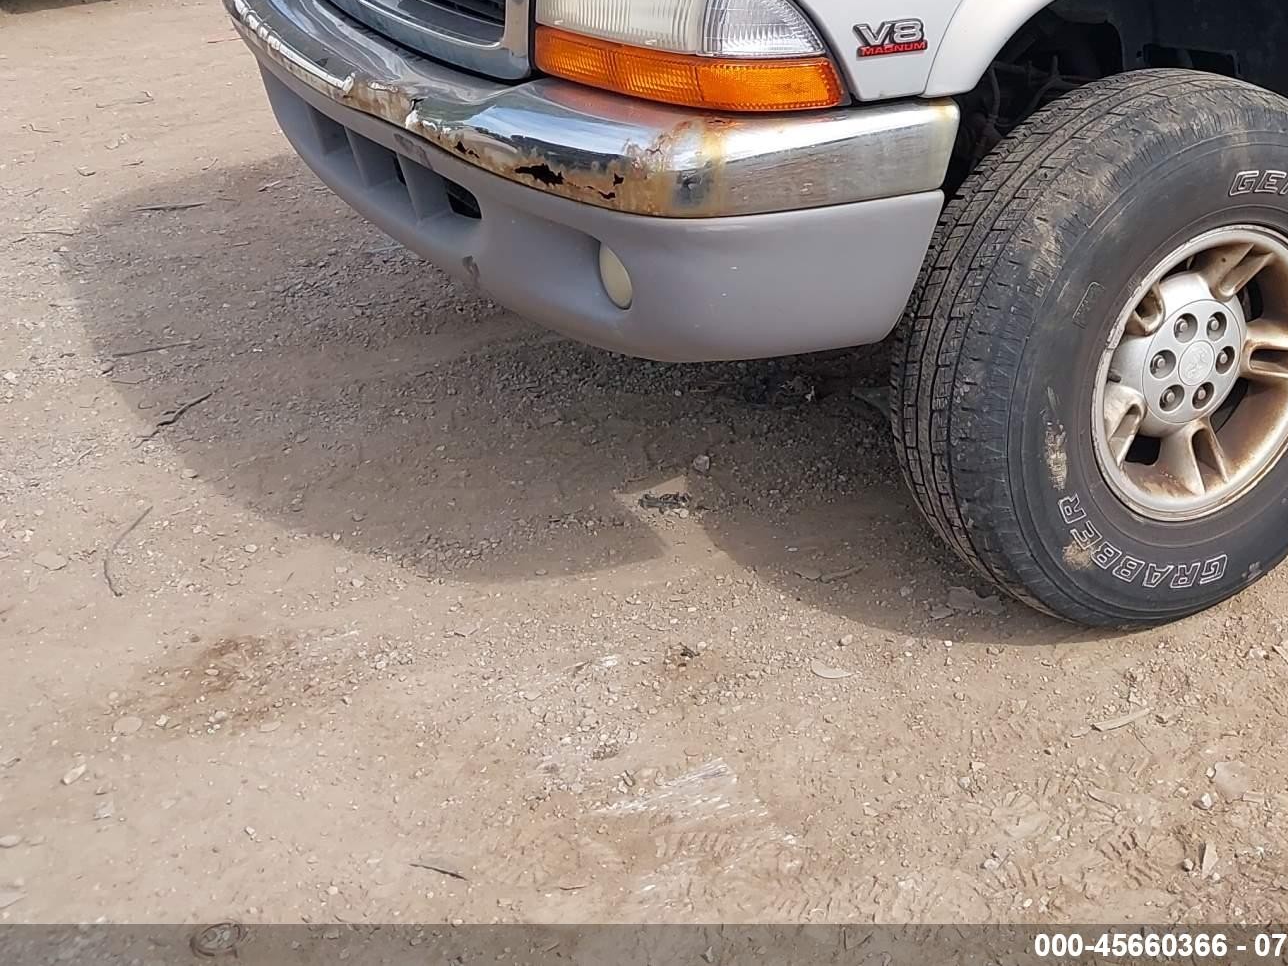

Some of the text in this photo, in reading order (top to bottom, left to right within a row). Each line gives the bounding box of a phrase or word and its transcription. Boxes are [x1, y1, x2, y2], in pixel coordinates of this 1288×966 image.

[853, 18, 924, 46] V8
[859, 40, 927, 56] MAGNUM
[1058, 492, 1228, 589] GRABBER
